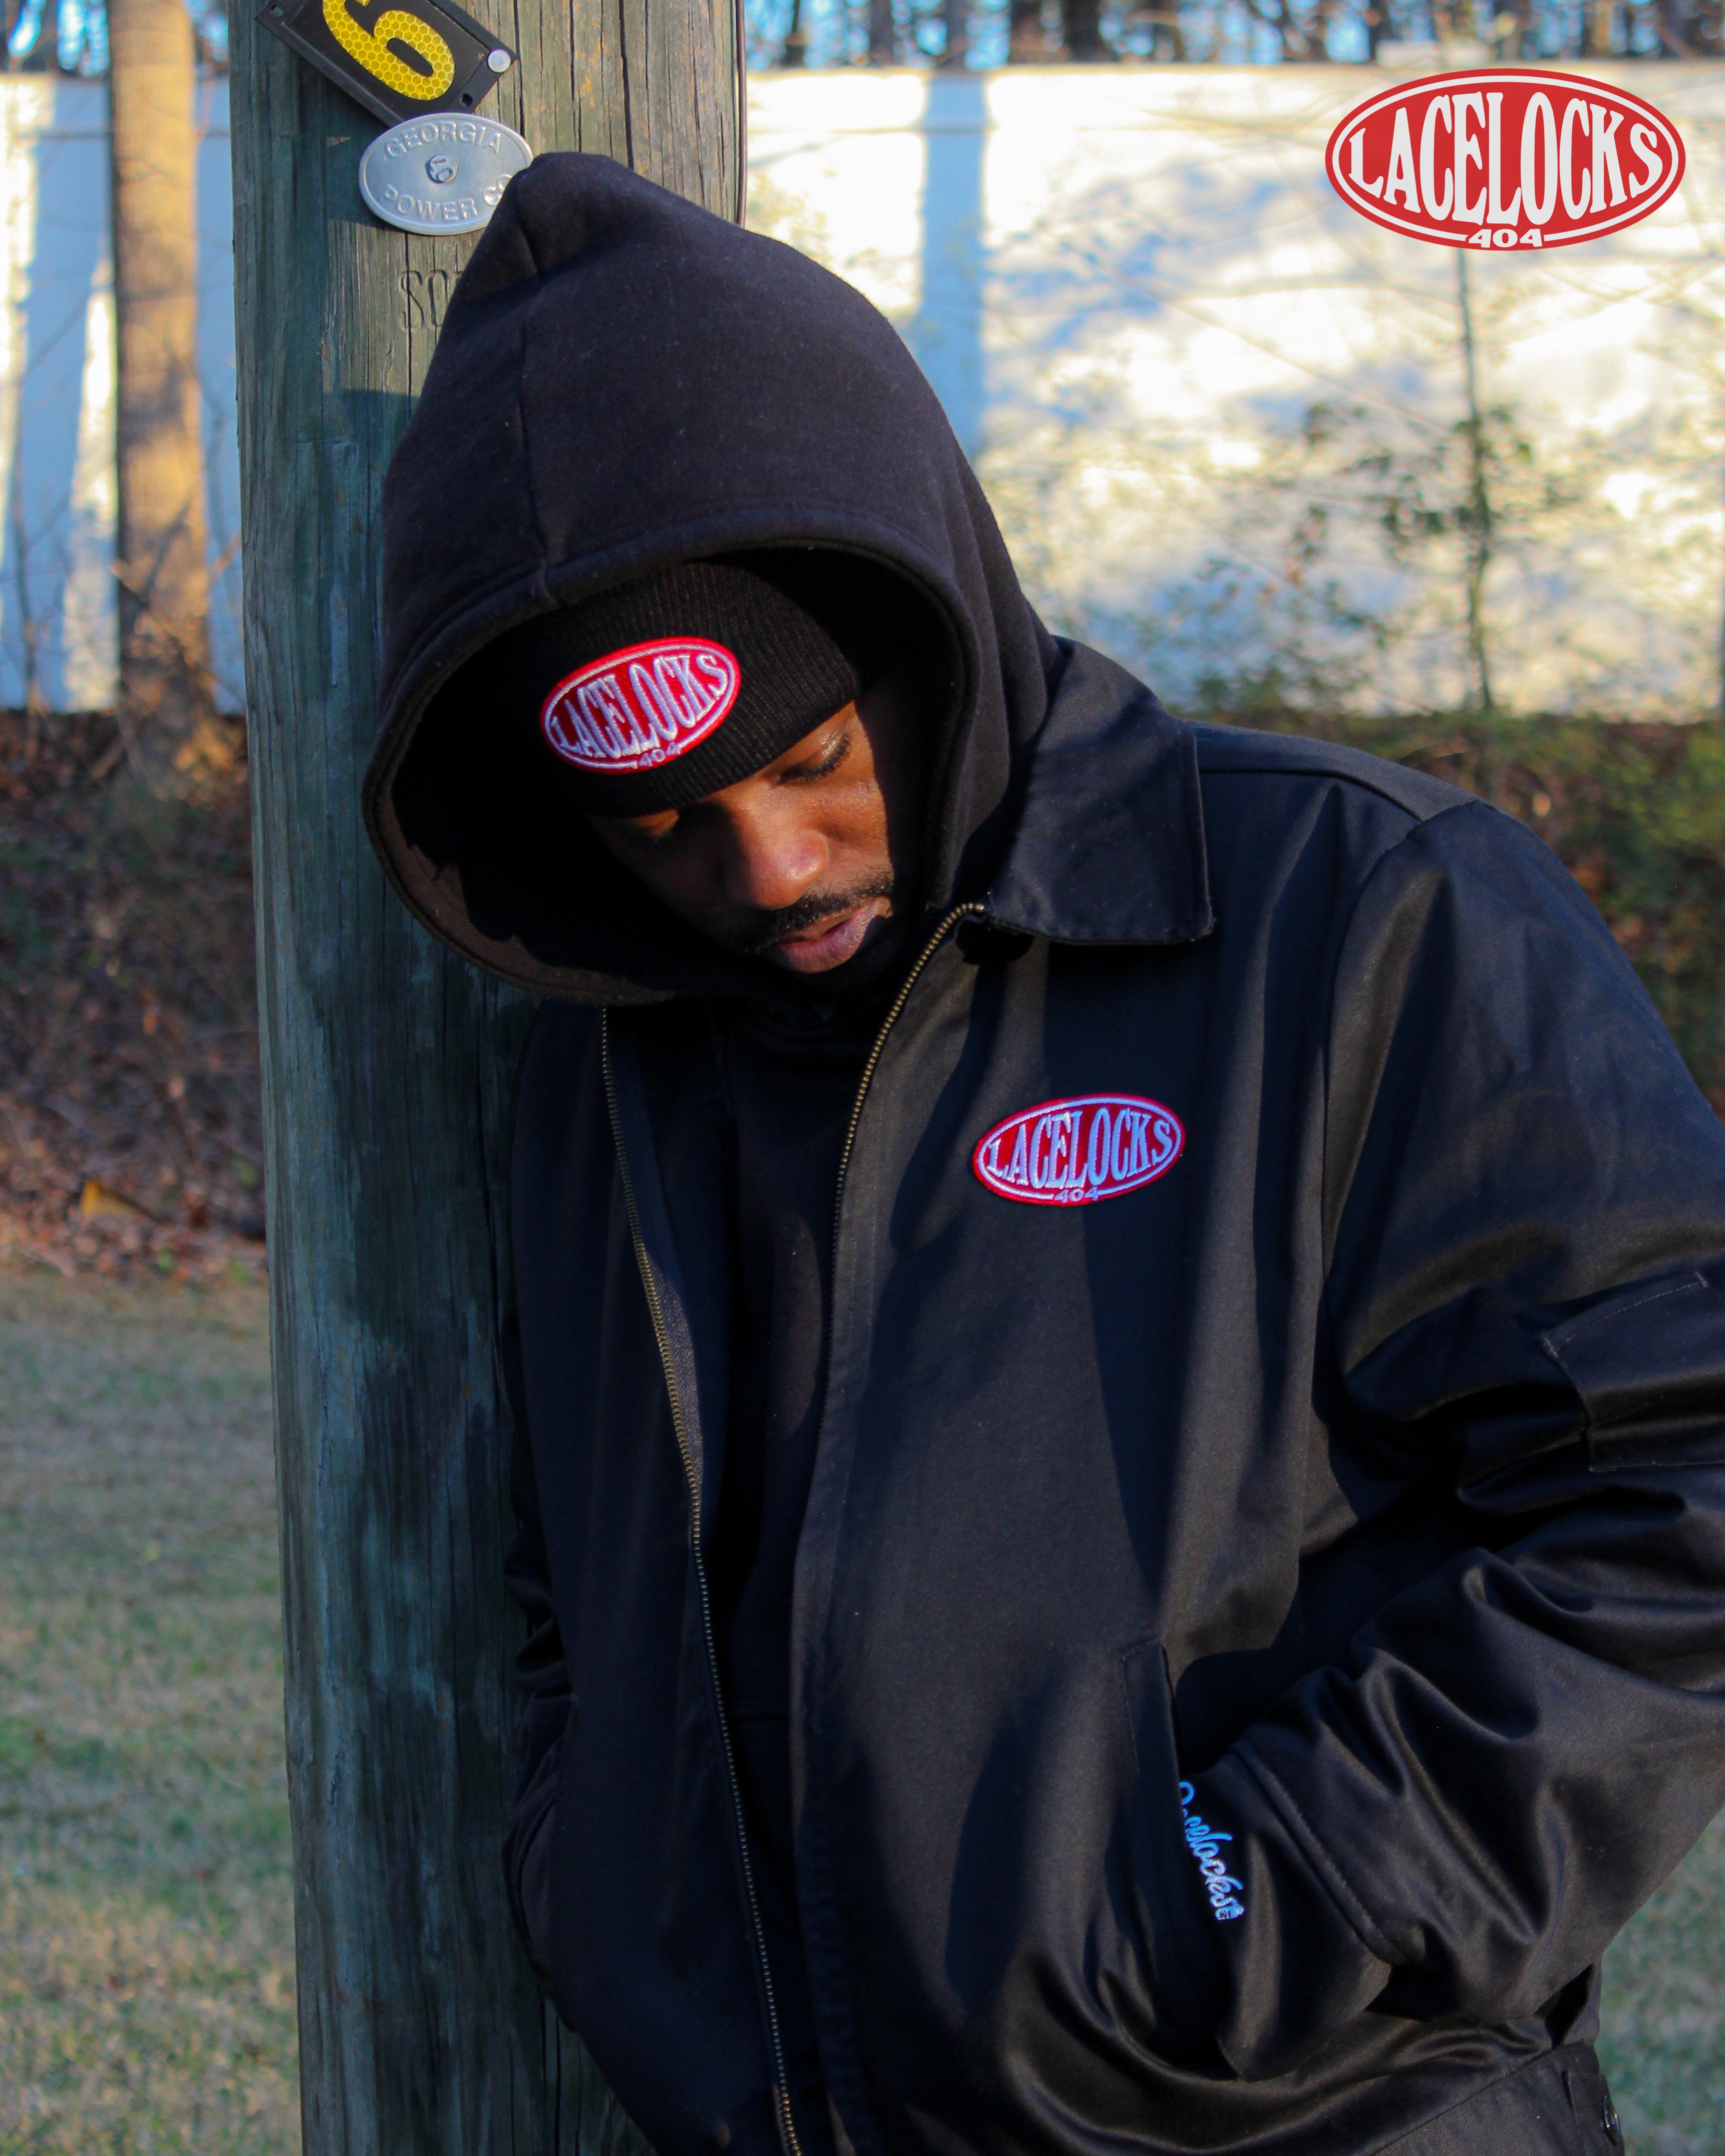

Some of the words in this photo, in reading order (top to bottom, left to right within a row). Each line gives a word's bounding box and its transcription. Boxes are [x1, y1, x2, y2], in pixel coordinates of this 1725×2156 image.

[322, 0, 455, 101] 6
[384, 121, 502, 159] GEORGIA
[383, 184, 478, 223] POWER
[398, 270, 463, 330] SO
[551, 653, 728, 760] LACELOCKS
[637, 742, 681, 768] 404
[987, 1107, 1173, 1189] LACELOCKS
[1054, 1186, 1099, 1203] 404
